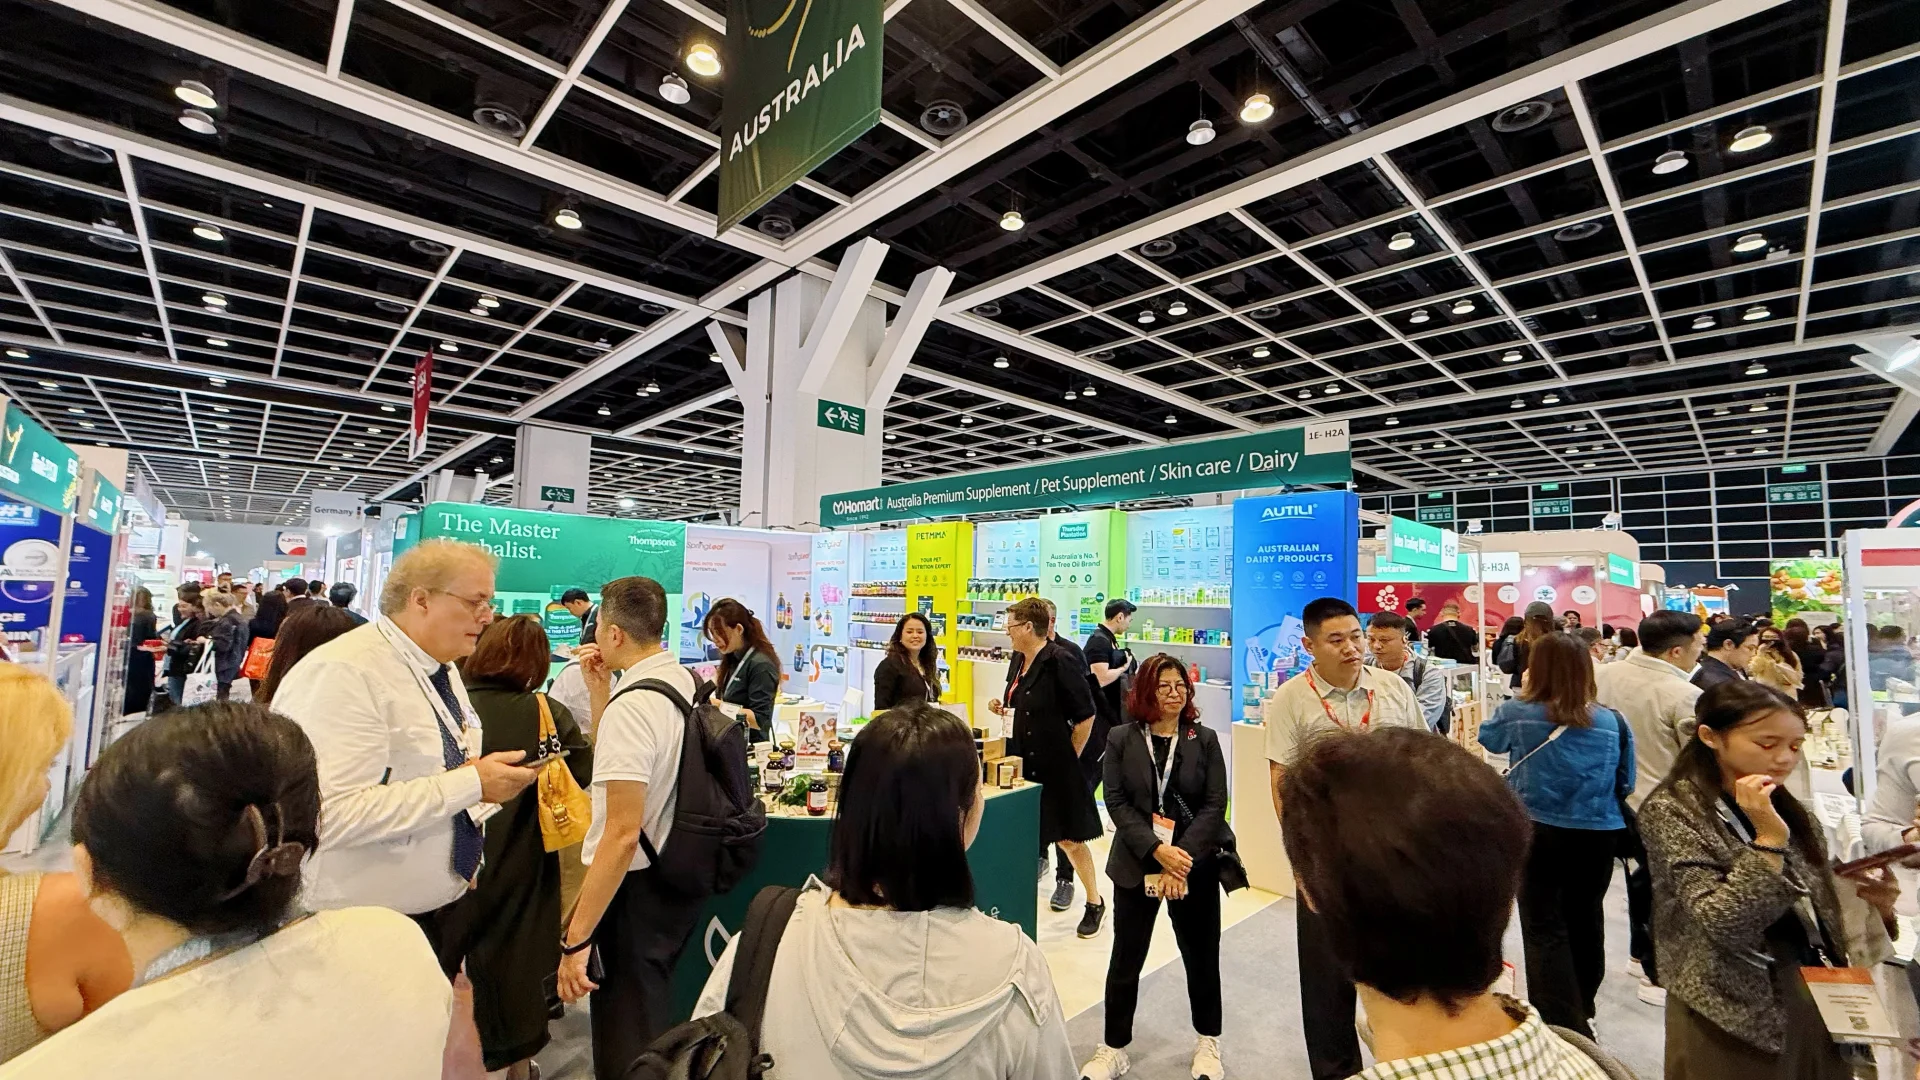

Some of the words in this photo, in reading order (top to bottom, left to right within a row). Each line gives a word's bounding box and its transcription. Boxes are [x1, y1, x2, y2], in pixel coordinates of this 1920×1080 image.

[729, 24, 865, 161] AUSTRALIA
[1324, 428, 1344, 439] H2A
[845, 497, 879, 514] Homart
[887, 493, 921, 509] Australia
[923, 490, 964, 505] Premium
[966, 482, 1031, 502] Supplement
[1041, 478, 1061, 493] Pet
[1063, 468, 1145, 493] Supplement
[1159, 462, 1192, 481] Skin
[1196, 459, 1231, 477] care
[1249, 450, 1298, 472] Dairy
[314, 506, 353, 516] Germany
[1261, 505, 1313, 518] AUTILI
[438, 512, 483, 533] The
[489, 517, 560, 540] Master
[438, 535, 542, 560] balist.
[1258, 543, 1320, 553] AUSTRALIAN
[1246, 555, 1275, 564] DAIRY
[1278, 554, 1333, 563] PRODUCTS
